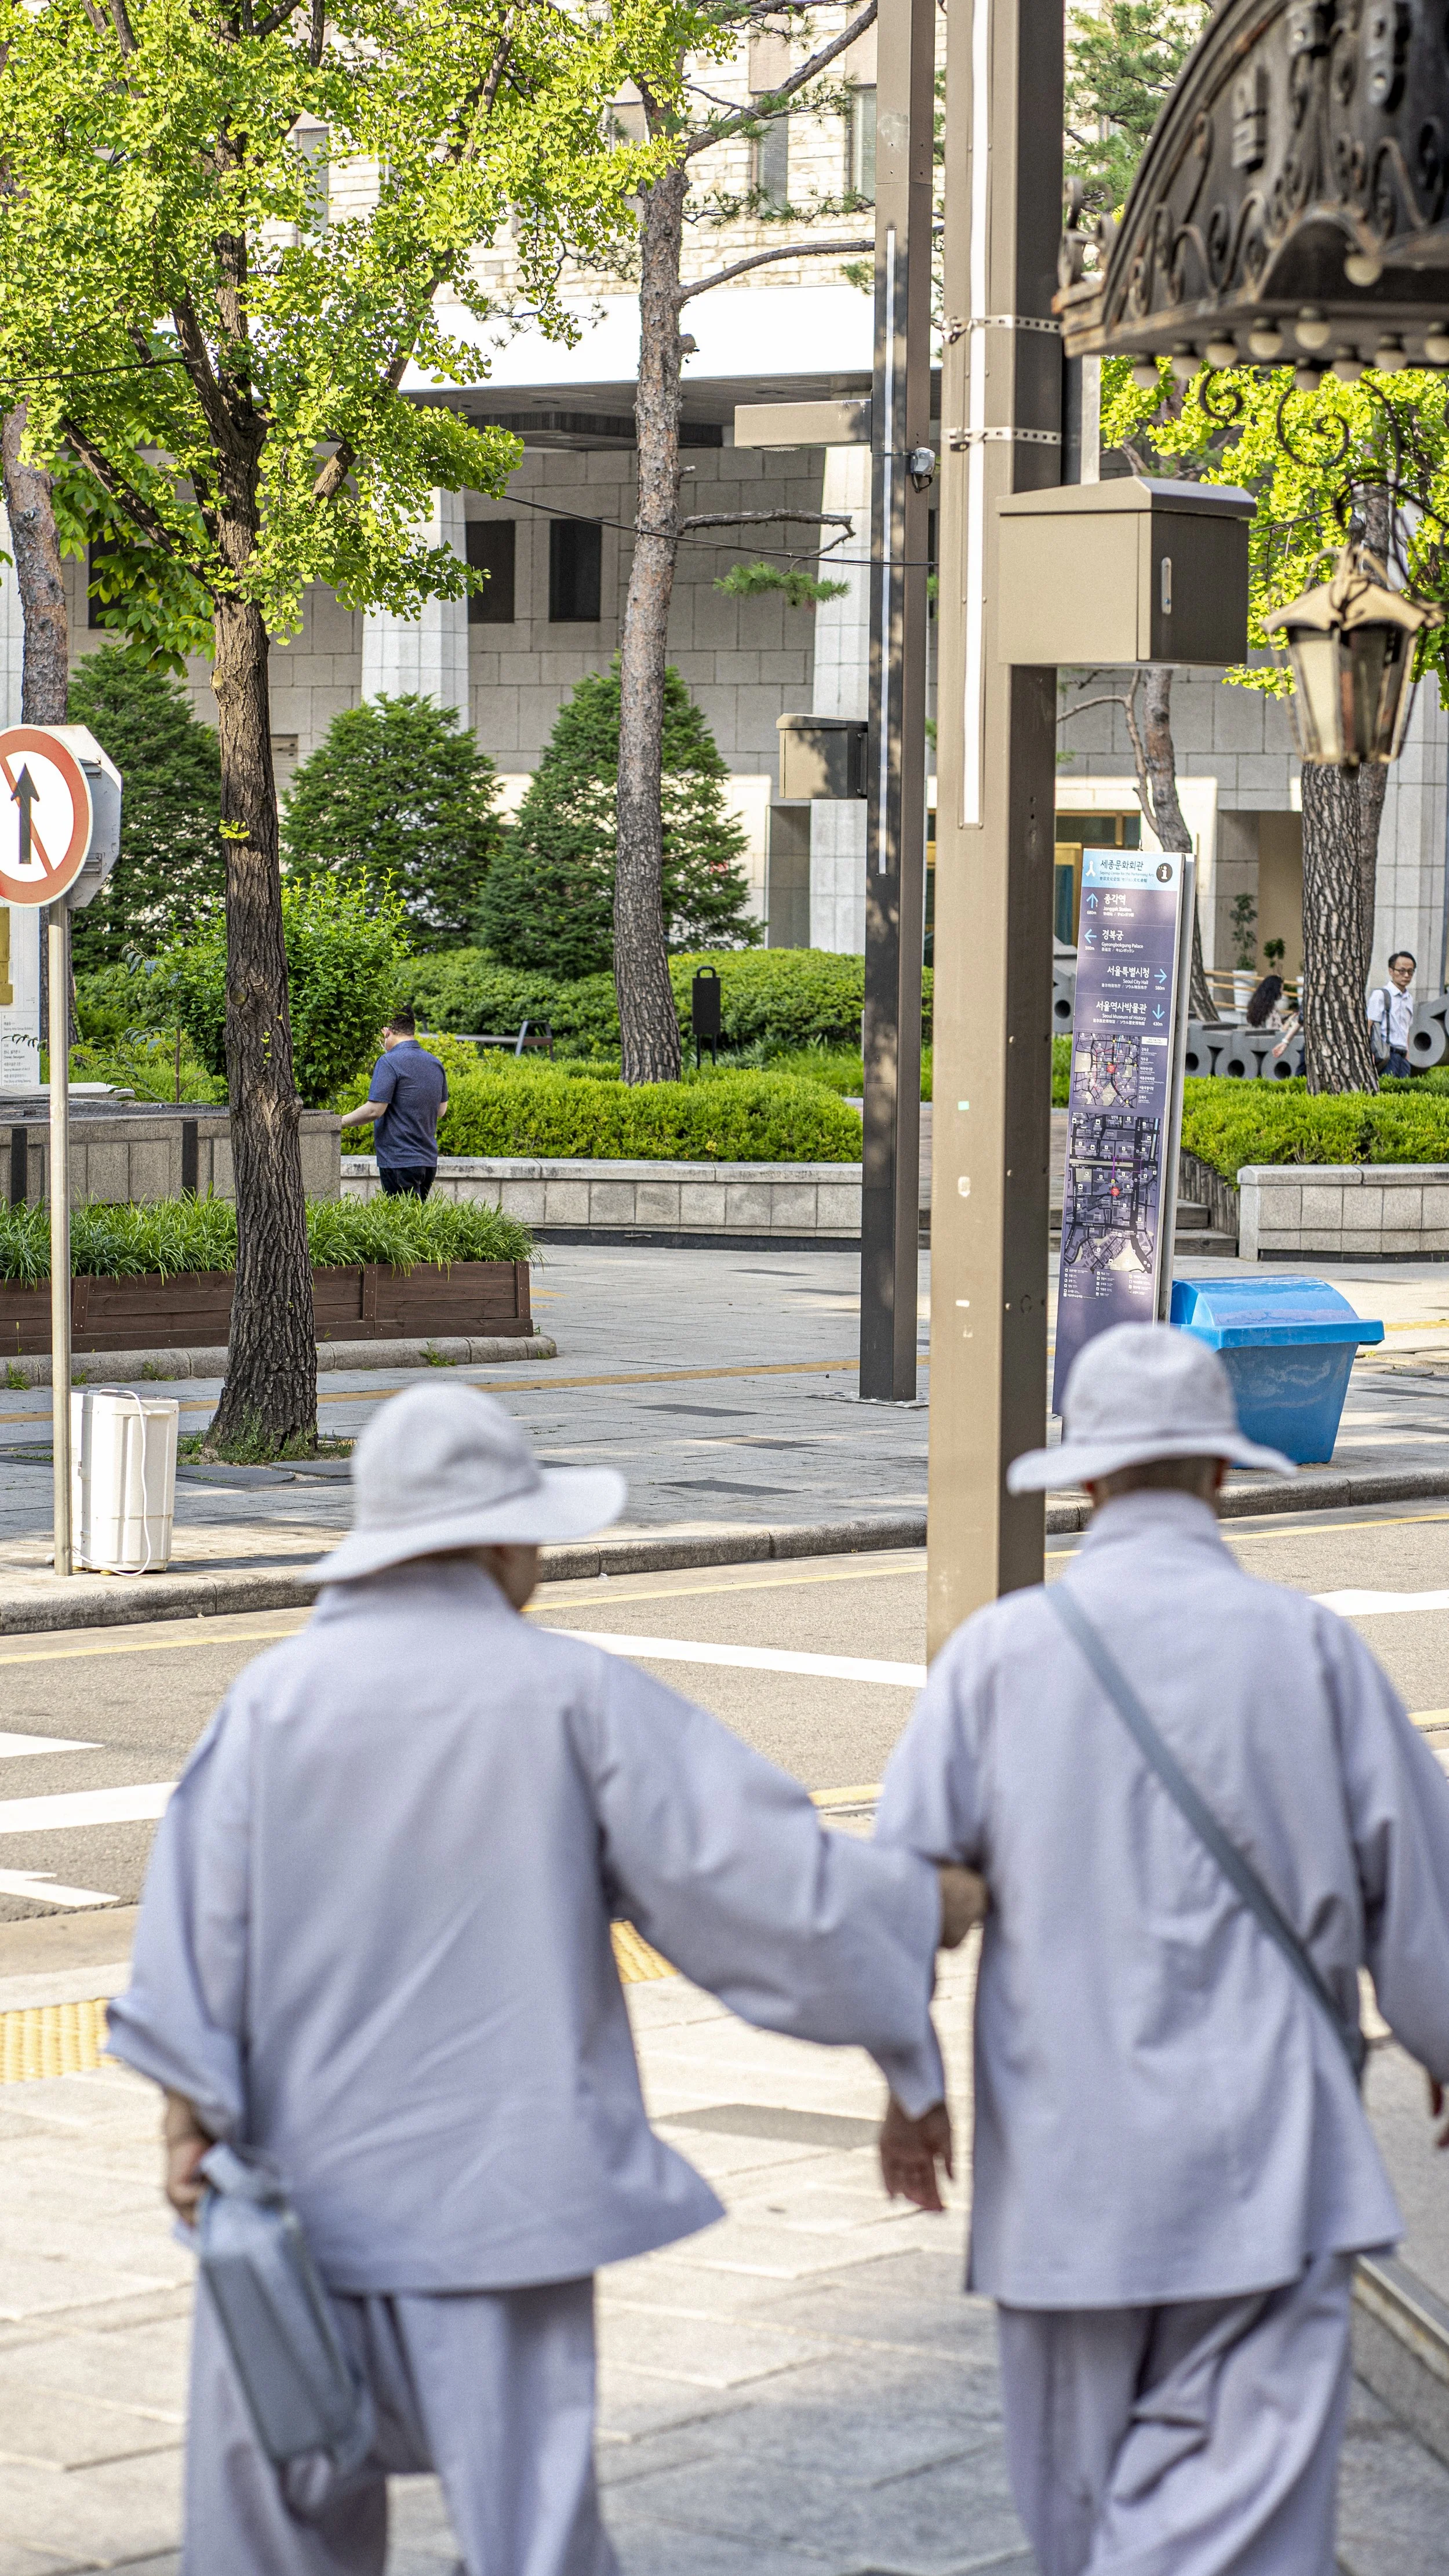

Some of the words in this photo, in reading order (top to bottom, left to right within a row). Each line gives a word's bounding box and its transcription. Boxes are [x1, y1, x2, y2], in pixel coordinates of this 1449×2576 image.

[1101, 859, 1144, 871] 세종문화회관
[1104, 893, 1126, 905] 종각역
[1102, 929, 1124, 940] 경복궁
[1107, 966, 1149, 978] 서울특별시청
[1096, 1001, 1147, 1014] 서울역사박물관
